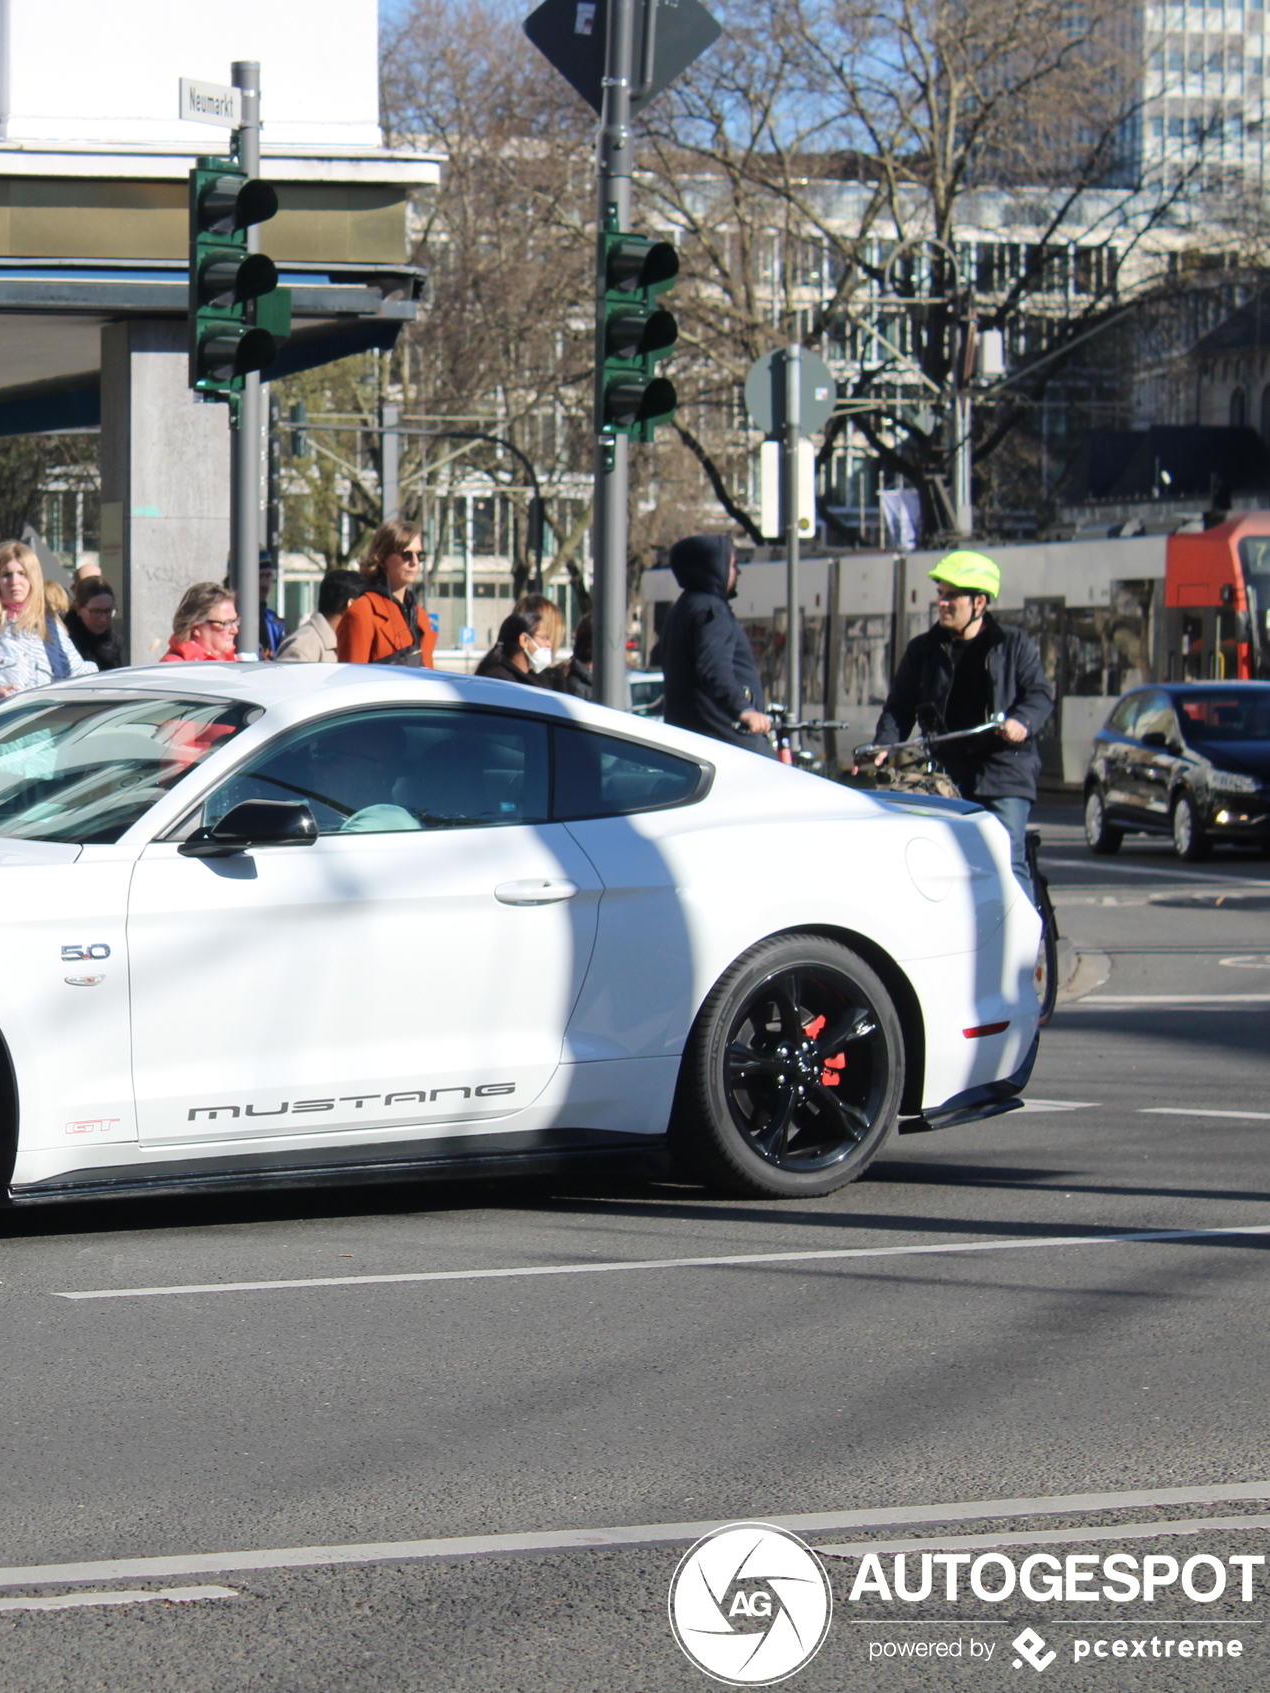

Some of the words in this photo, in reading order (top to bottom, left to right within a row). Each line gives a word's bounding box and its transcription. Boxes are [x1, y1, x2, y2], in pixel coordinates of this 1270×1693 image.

[189, 86, 233, 118] Neumarkt
[1255, 542, 1267, 567] 7
[61, 943, 111, 962] 5.0
[187, 1082, 516, 1121] MUSTANG
[65, 1118, 121, 1135] GT
